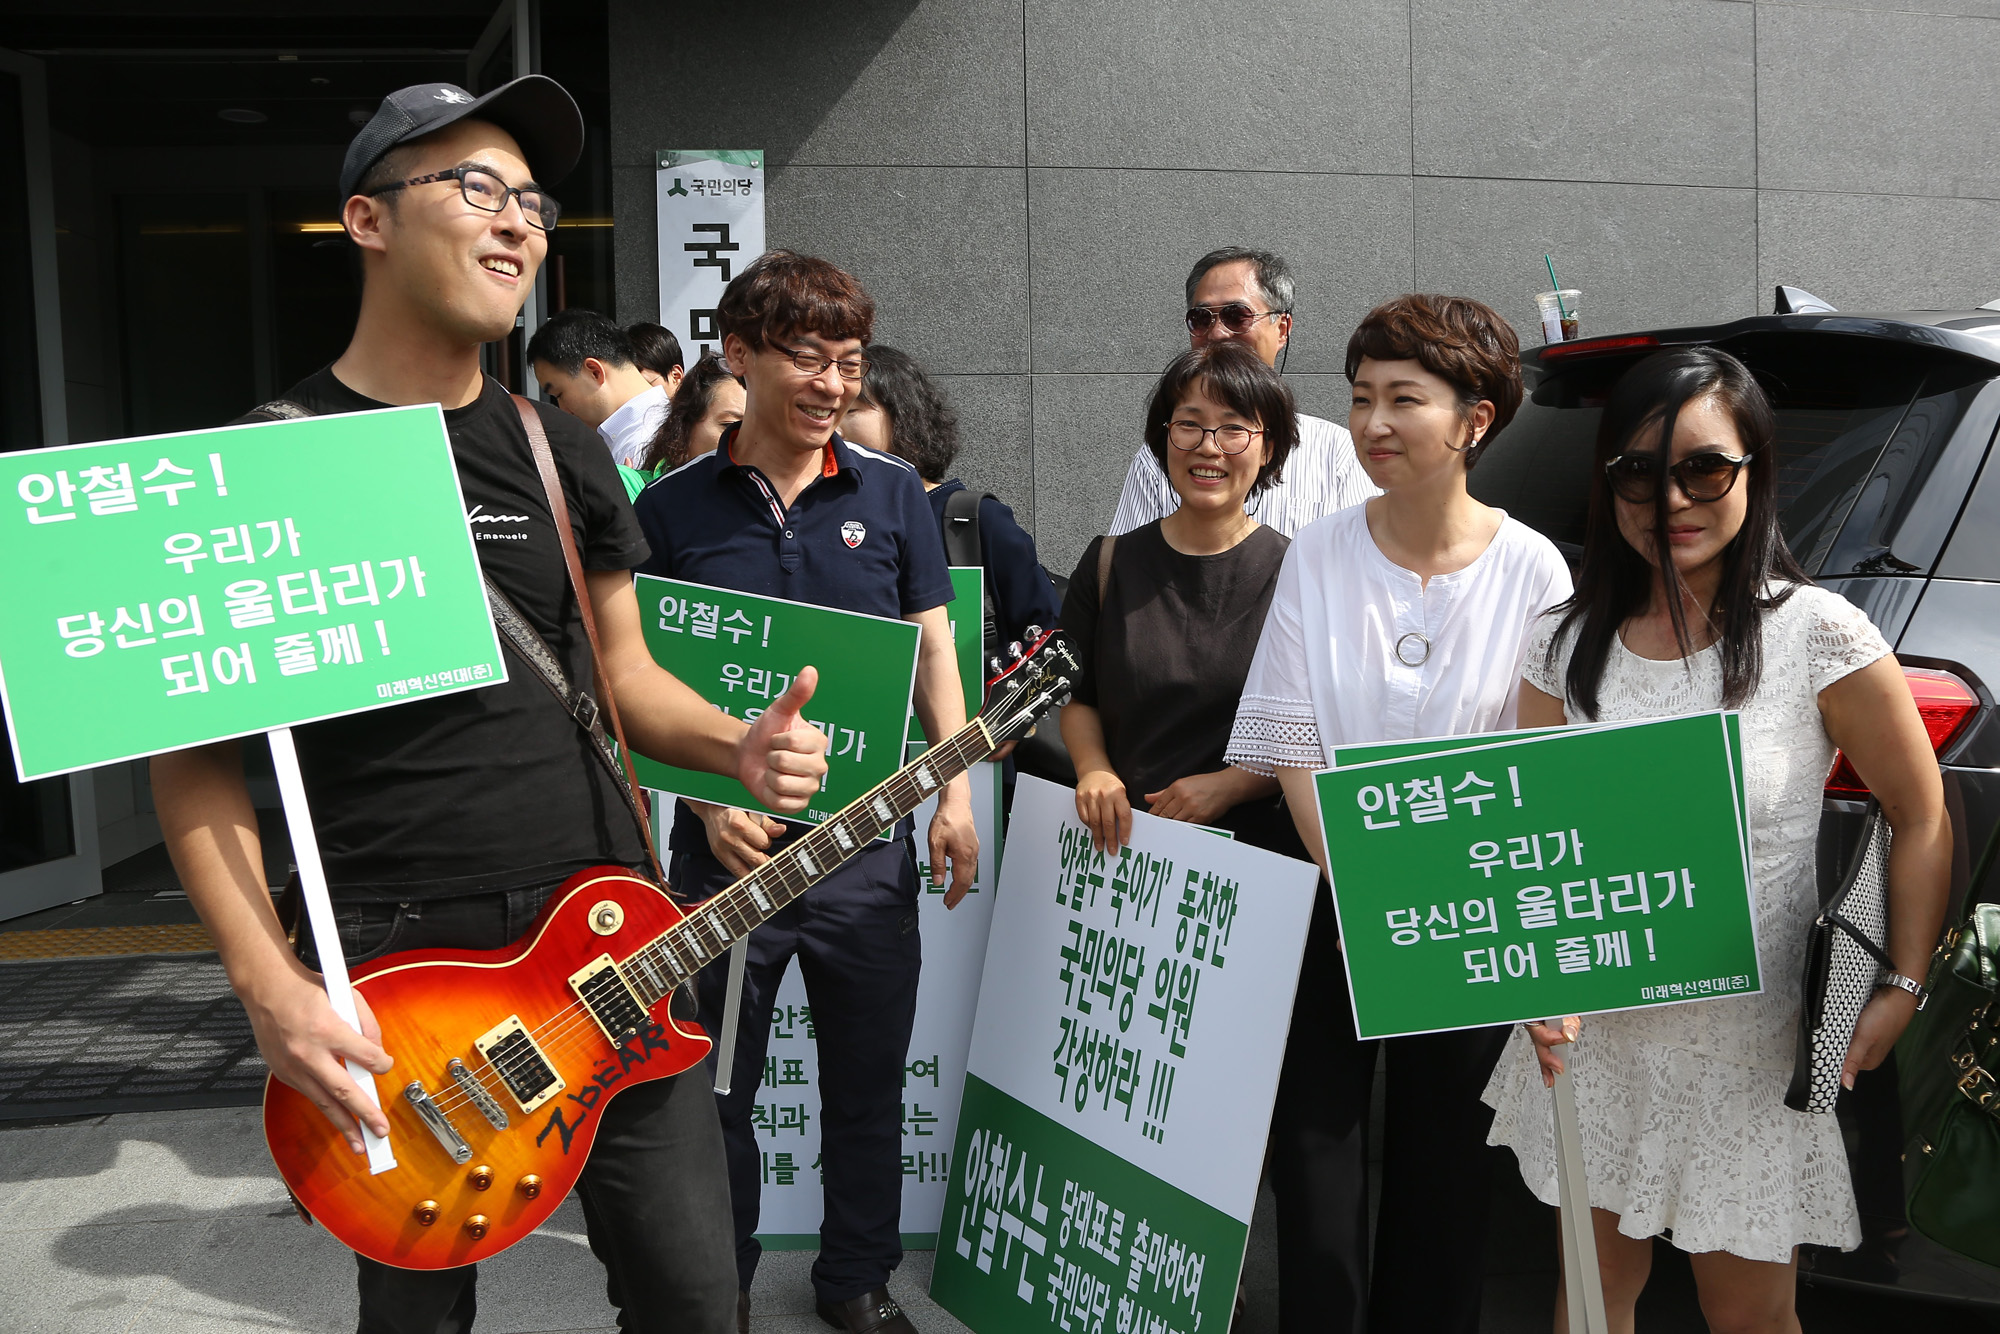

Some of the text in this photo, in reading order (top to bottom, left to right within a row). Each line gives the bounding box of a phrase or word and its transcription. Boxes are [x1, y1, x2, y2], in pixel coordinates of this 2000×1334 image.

[690, 178, 753, 197] 국민의당
[164, 517, 301, 574] 우리가
[475, 532, 528, 540] Emanuele
[57, 556, 427, 658] 당신의 울타리가
[161, 642, 257, 697] 되어
[377, 663, 494, 700] 미래혁신연대(준)
[1469, 828, 1584, 878] 우리가
[1176, 868, 1239, 969] 동참한
[1385, 867, 1696, 946] 당신의 울타리가
[1059, 919, 1200, 1059] 국민의당 의원
[1463, 941, 1540, 984] 되어
[1641, 974, 1750, 1000] 미래혁신연대(준)
[1053, 1016, 1142, 1123] 각성하라
[956, 1128, 1049, 1305] 안철수는
[1059, 1179, 1126, 1266] 당대표로
